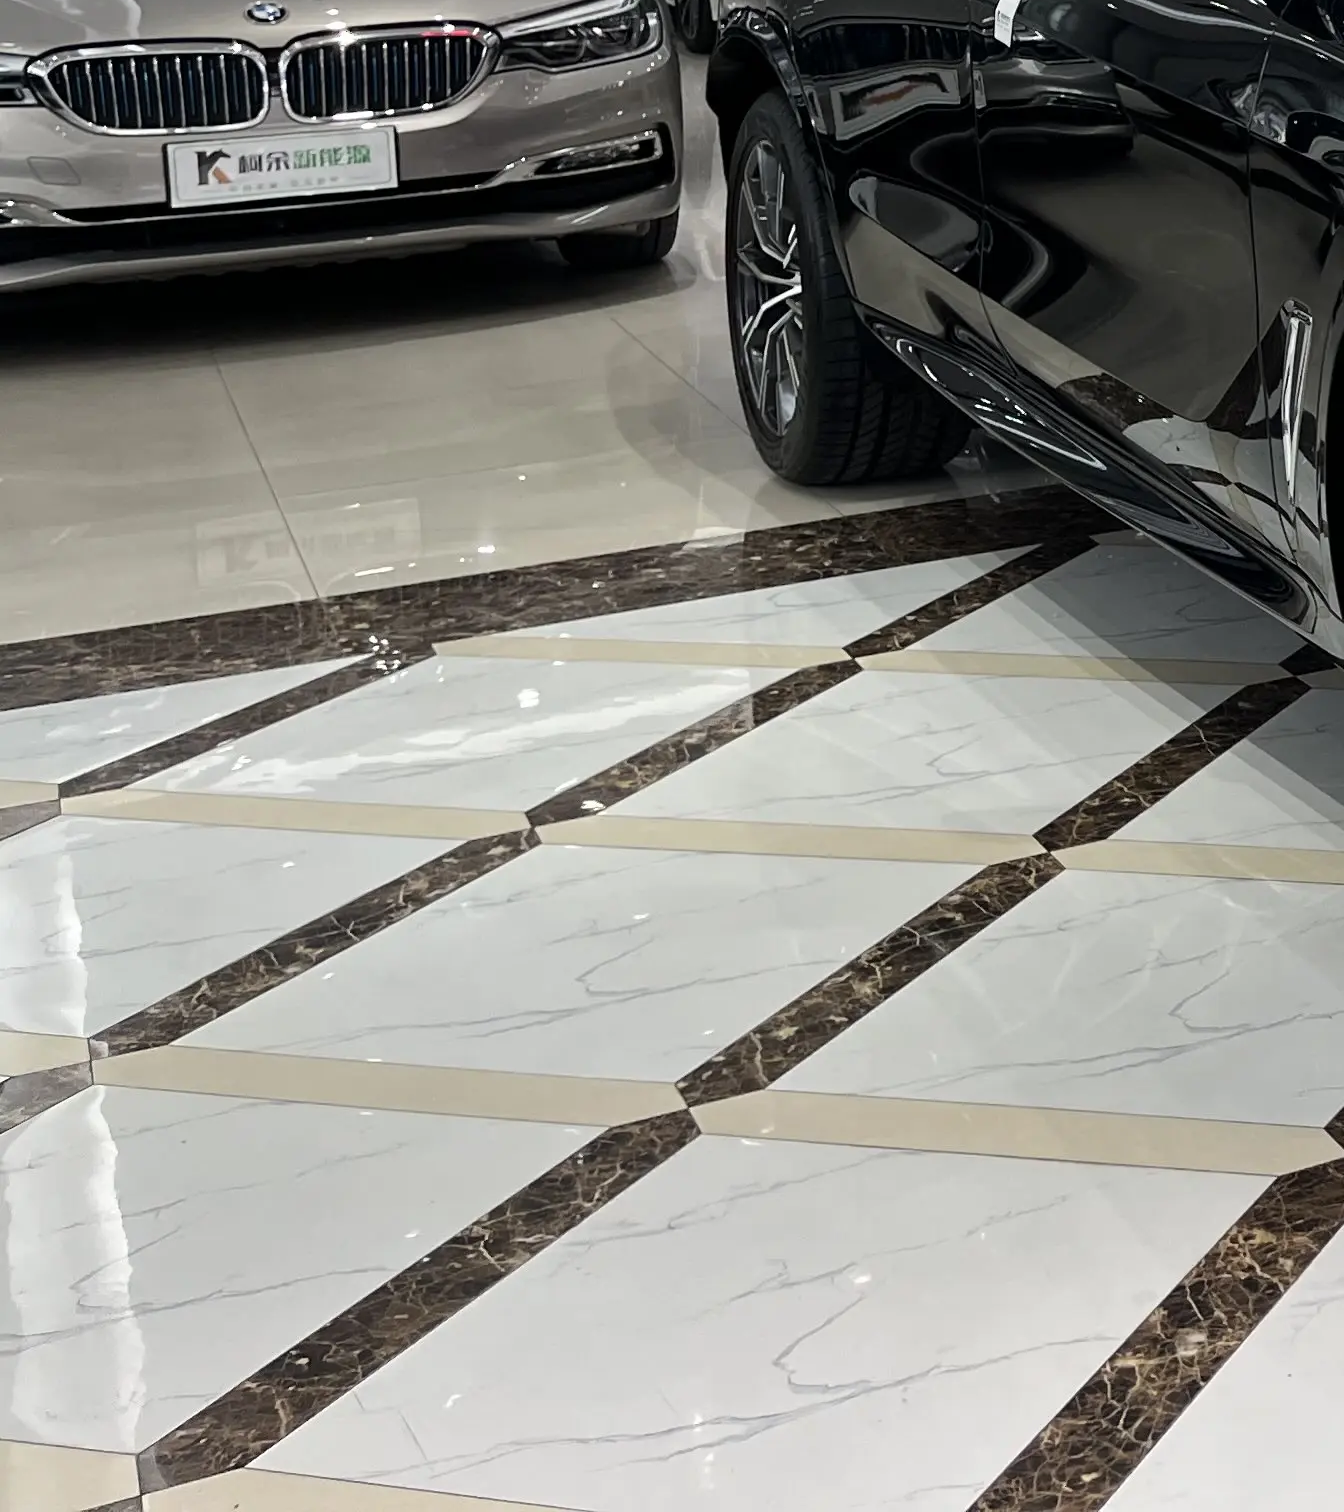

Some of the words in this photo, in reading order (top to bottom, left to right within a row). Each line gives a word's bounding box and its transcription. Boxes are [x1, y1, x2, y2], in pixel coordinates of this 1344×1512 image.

[238, 144, 372, 174] 柯余新能源
